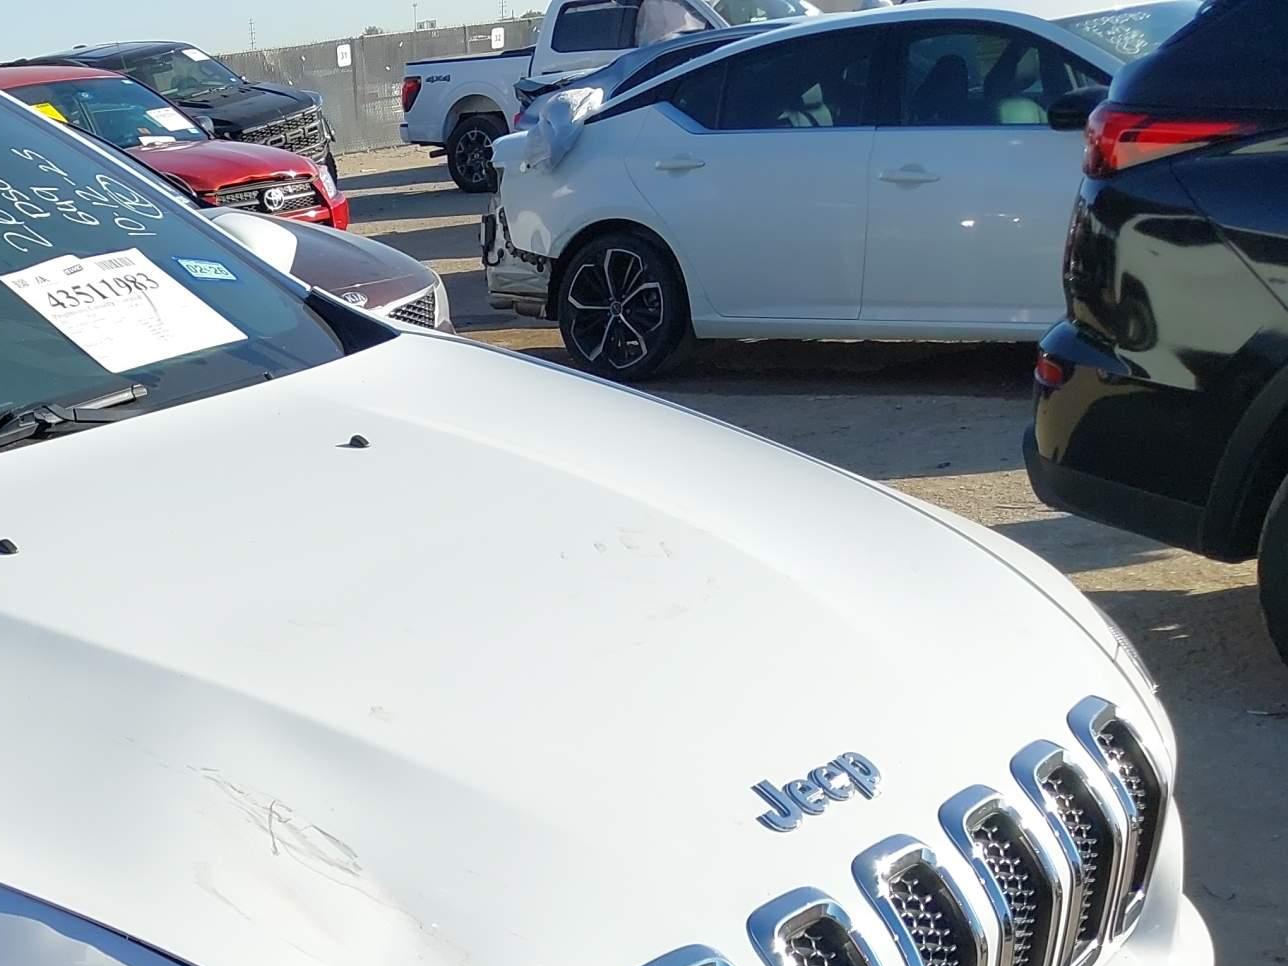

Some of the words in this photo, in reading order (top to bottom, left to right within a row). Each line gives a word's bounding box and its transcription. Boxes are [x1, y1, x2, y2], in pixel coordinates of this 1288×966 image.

[30, 185, 101, 226] 649
[47, 272, 160, 309] 43511983
[750, 751, 882, 833] Jeep
